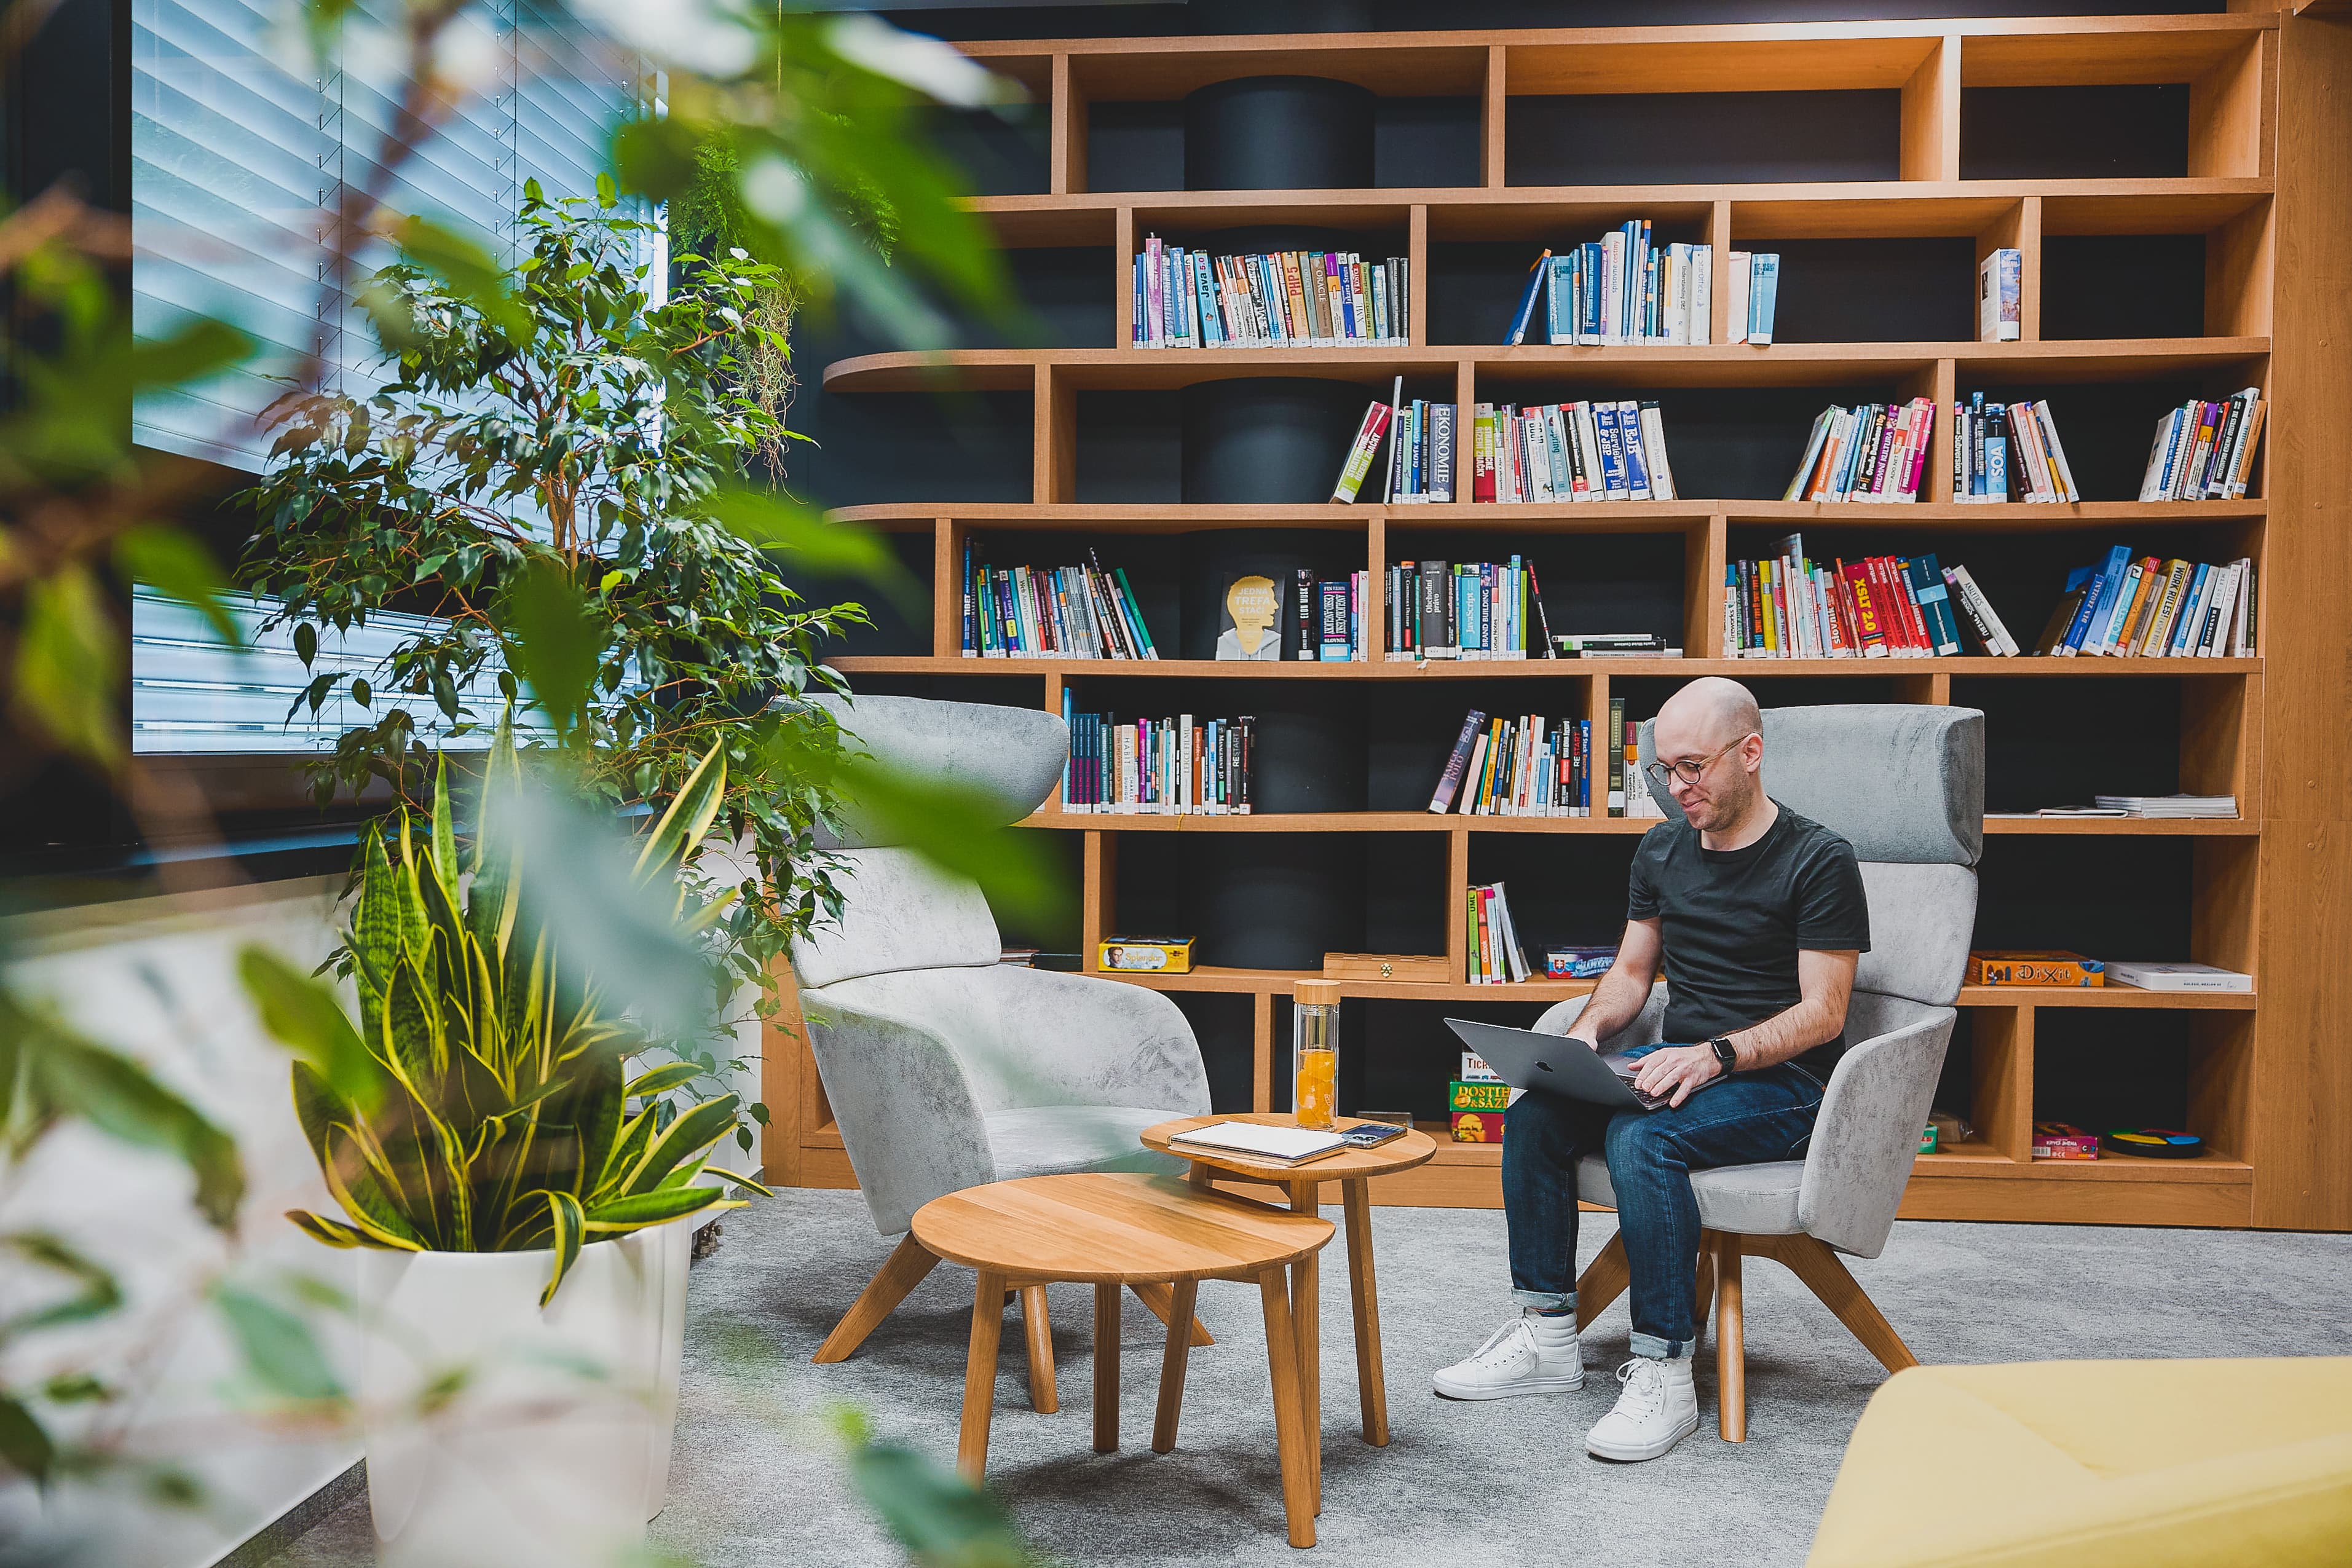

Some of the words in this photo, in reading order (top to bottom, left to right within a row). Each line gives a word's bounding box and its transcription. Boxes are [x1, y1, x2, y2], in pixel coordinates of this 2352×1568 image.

[1200, 272, 1209, 297] Java
[1288, 275, 1301, 296] PHP
[1316, 269, 1326, 302] ORACLE
[1438, 407, 1450, 483] EKONOMIE
[1601, 438, 1612, 455] JSP
[1609, 428, 1621, 465] Servlets
[1625, 427, 1638, 455] EJB
[1873, 462, 1885, 490] FIREMNÍ
[1880, 431, 1893, 462] KULTURA
[1991, 445, 2004, 477] SOA
[2169, 567, 2185, 592] WORK
[2226, 569, 2240, 602] REMOTE
[1234, 596, 1270, 605] TREFA
[1300, 588, 1308, 604] MUSK
[1433, 593, 1442, 613] právo
[1853, 578, 1871, 608] XSLT
[1862, 610, 1877, 631] 2.0
[2161, 591, 2177, 618] RULES!
[1300, 605, 1309, 618] ELON
[1465, 592, 1475, 634] JavaScript
[2204, 610, 2218, 645] HANDBOOK
[1443, 749, 1459, 781] MARCO
[1450, 755, 1464, 781] POLO
[1126, 951, 1162, 963] Splendor
[1467, 1058, 1490, 1069] TICK
[1459, 1086, 1512, 1097] DOSTIH
[1478, 1097, 1508, 1108] SÁZ
